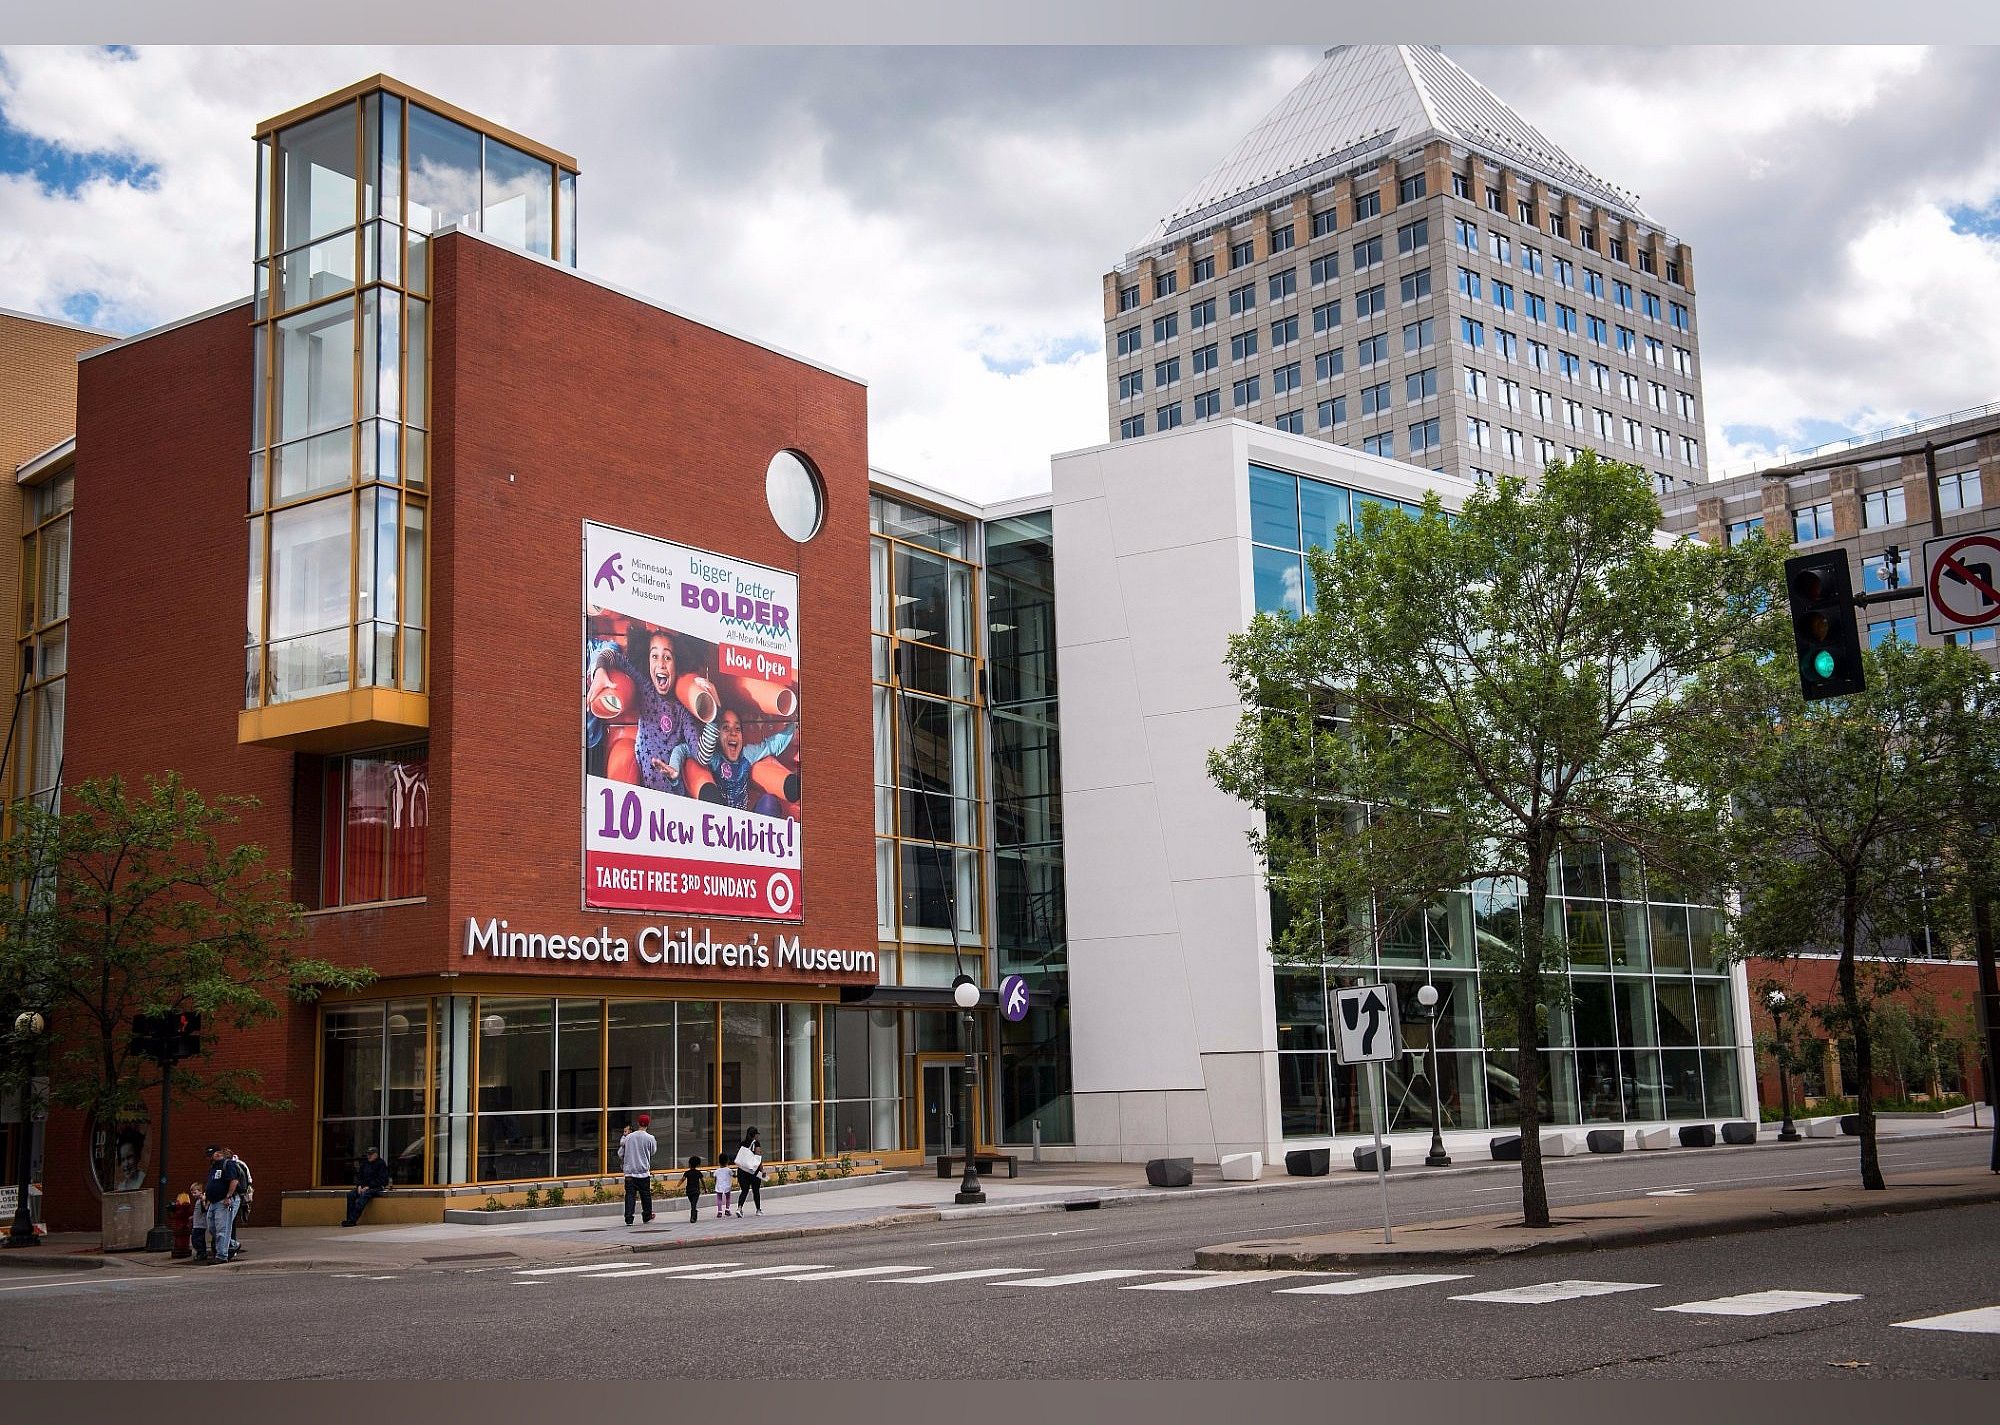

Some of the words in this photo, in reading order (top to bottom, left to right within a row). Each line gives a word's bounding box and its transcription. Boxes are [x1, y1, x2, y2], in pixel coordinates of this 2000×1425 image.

[631, 558, 673, 576] Minnesota
[631, 572, 671, 590] Children's
[690, 557, 732, 584] bigger
[736, 577, 775, 601] better
[632, 587, 665, 602] Museum
[681, 582, 789, 630] BOLDER
[726, 629, 755, 644] All-New
[755, 636, 787, 651] Museum!
[726, 648, 752, 669] Now
[756, 656, 786, 679] Open
[599, 788, 642, 840] 10
[649, 809, 694, 844] New
[702, 814, 793, 858] Exhibits!
[596, 866, 645, 891] TARGET
[647, 872, 678, 893] FREE
[681, 873, 700, 894] 3RD
[703, 875, 757, 899] SUNDAYS
[465, 917, 629, 962] Minnesota
[638, 925, 769, 967] Children's
[776, 934, 876, 972] Museum
